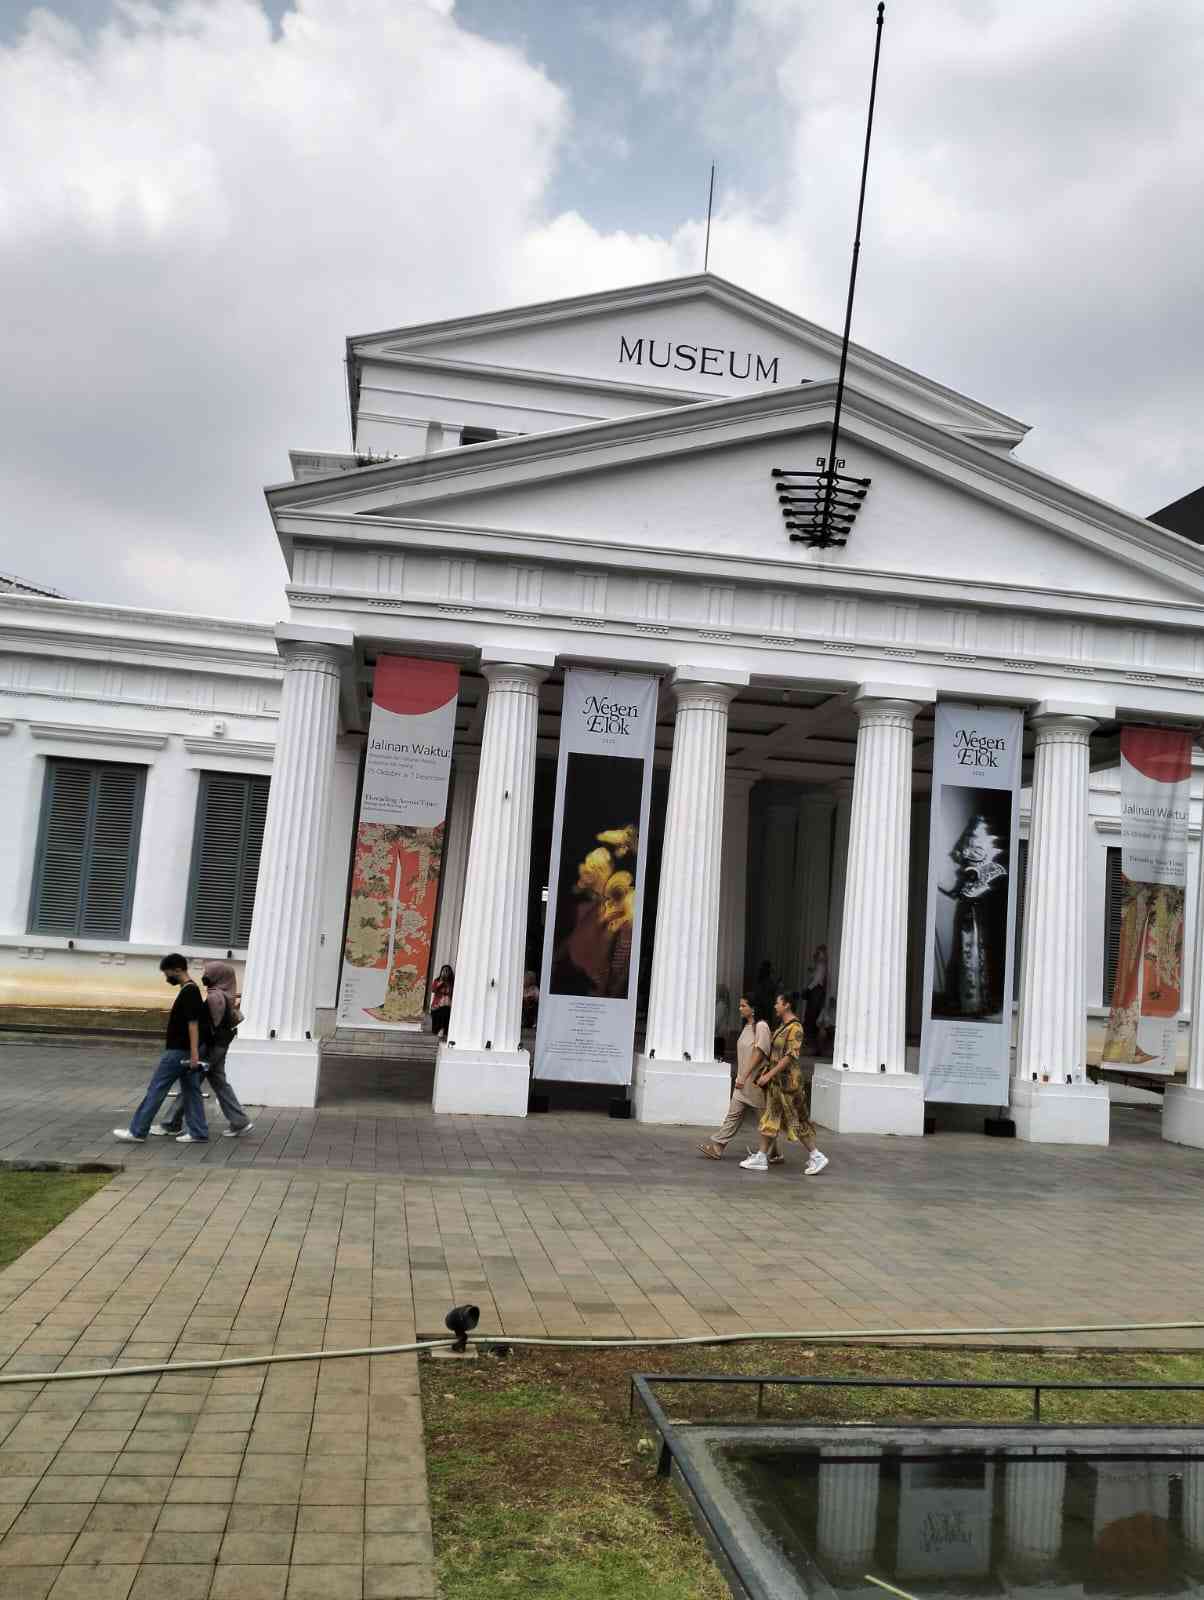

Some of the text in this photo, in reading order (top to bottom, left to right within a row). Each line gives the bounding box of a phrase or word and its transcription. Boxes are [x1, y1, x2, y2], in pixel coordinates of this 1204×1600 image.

[619, 335, 781, 383] MUSEUM
[587, 715, 629, 735] Elok
[369, 739, 409, 753] Jalinan
[957, 748, 999, 768] Elok
